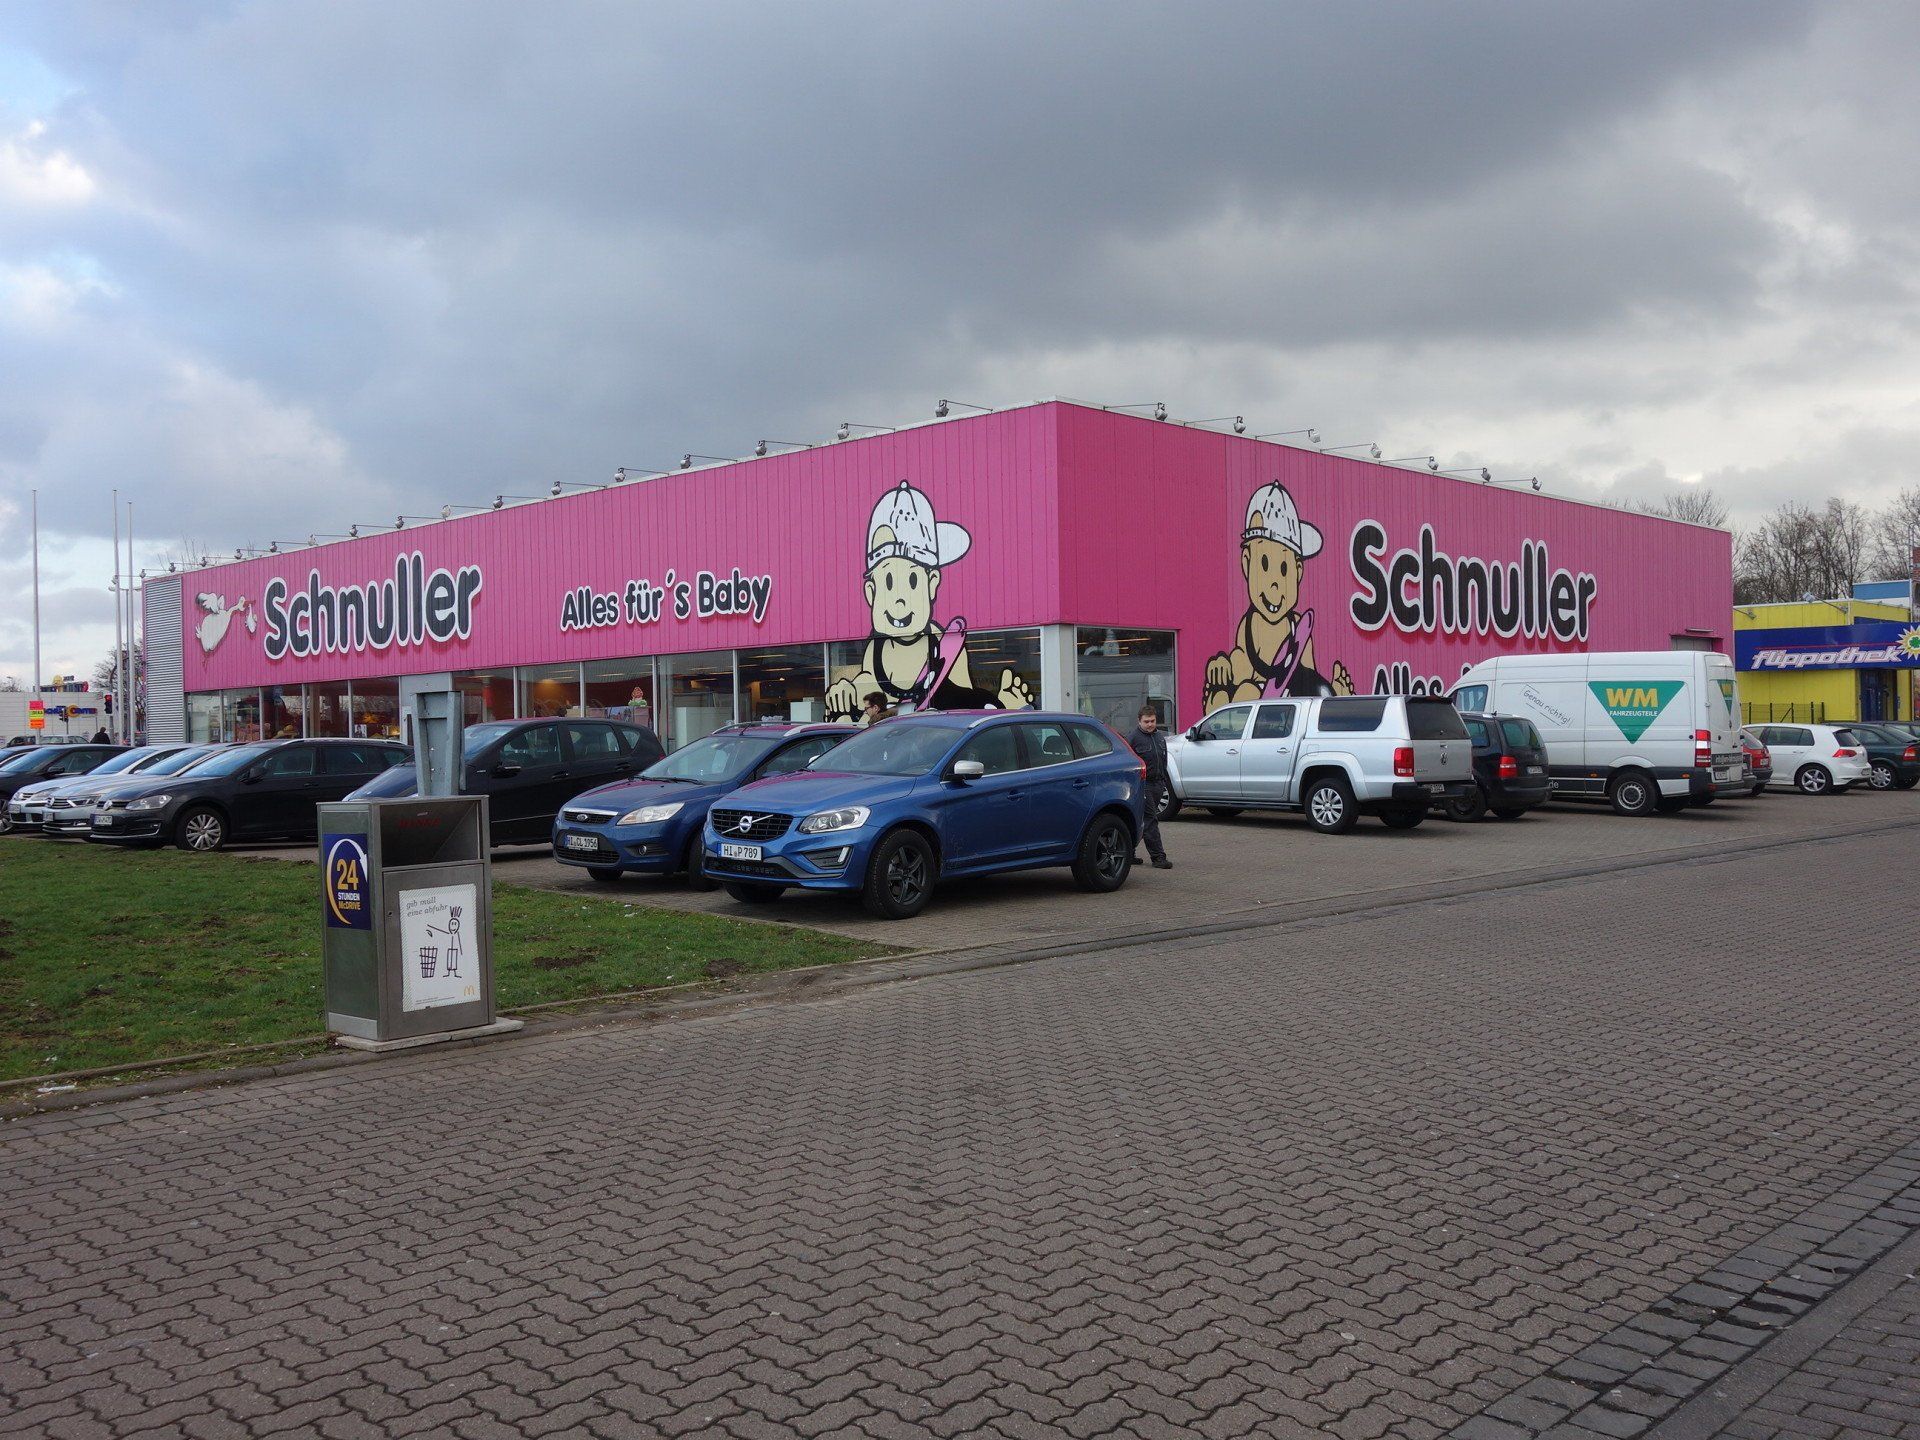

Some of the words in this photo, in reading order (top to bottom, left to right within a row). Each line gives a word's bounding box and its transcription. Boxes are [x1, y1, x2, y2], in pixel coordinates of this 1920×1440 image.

[1349, 519, 1598, 642] Schnuller
[264, 550, 483, 660] Schnuller
[560, 586, 619, 632] Alles
[696, 567, 771, 624] Baby
[1750, 645, 1903, 670] flippothek
[1523, 689, 1545, 708] Genau
[1606, 688, 1659, 708] WM
[723, 845, 733, 857] HI
[336, 858, 359, 891] 24
[338, 892, 361, 901] STUNDEN
